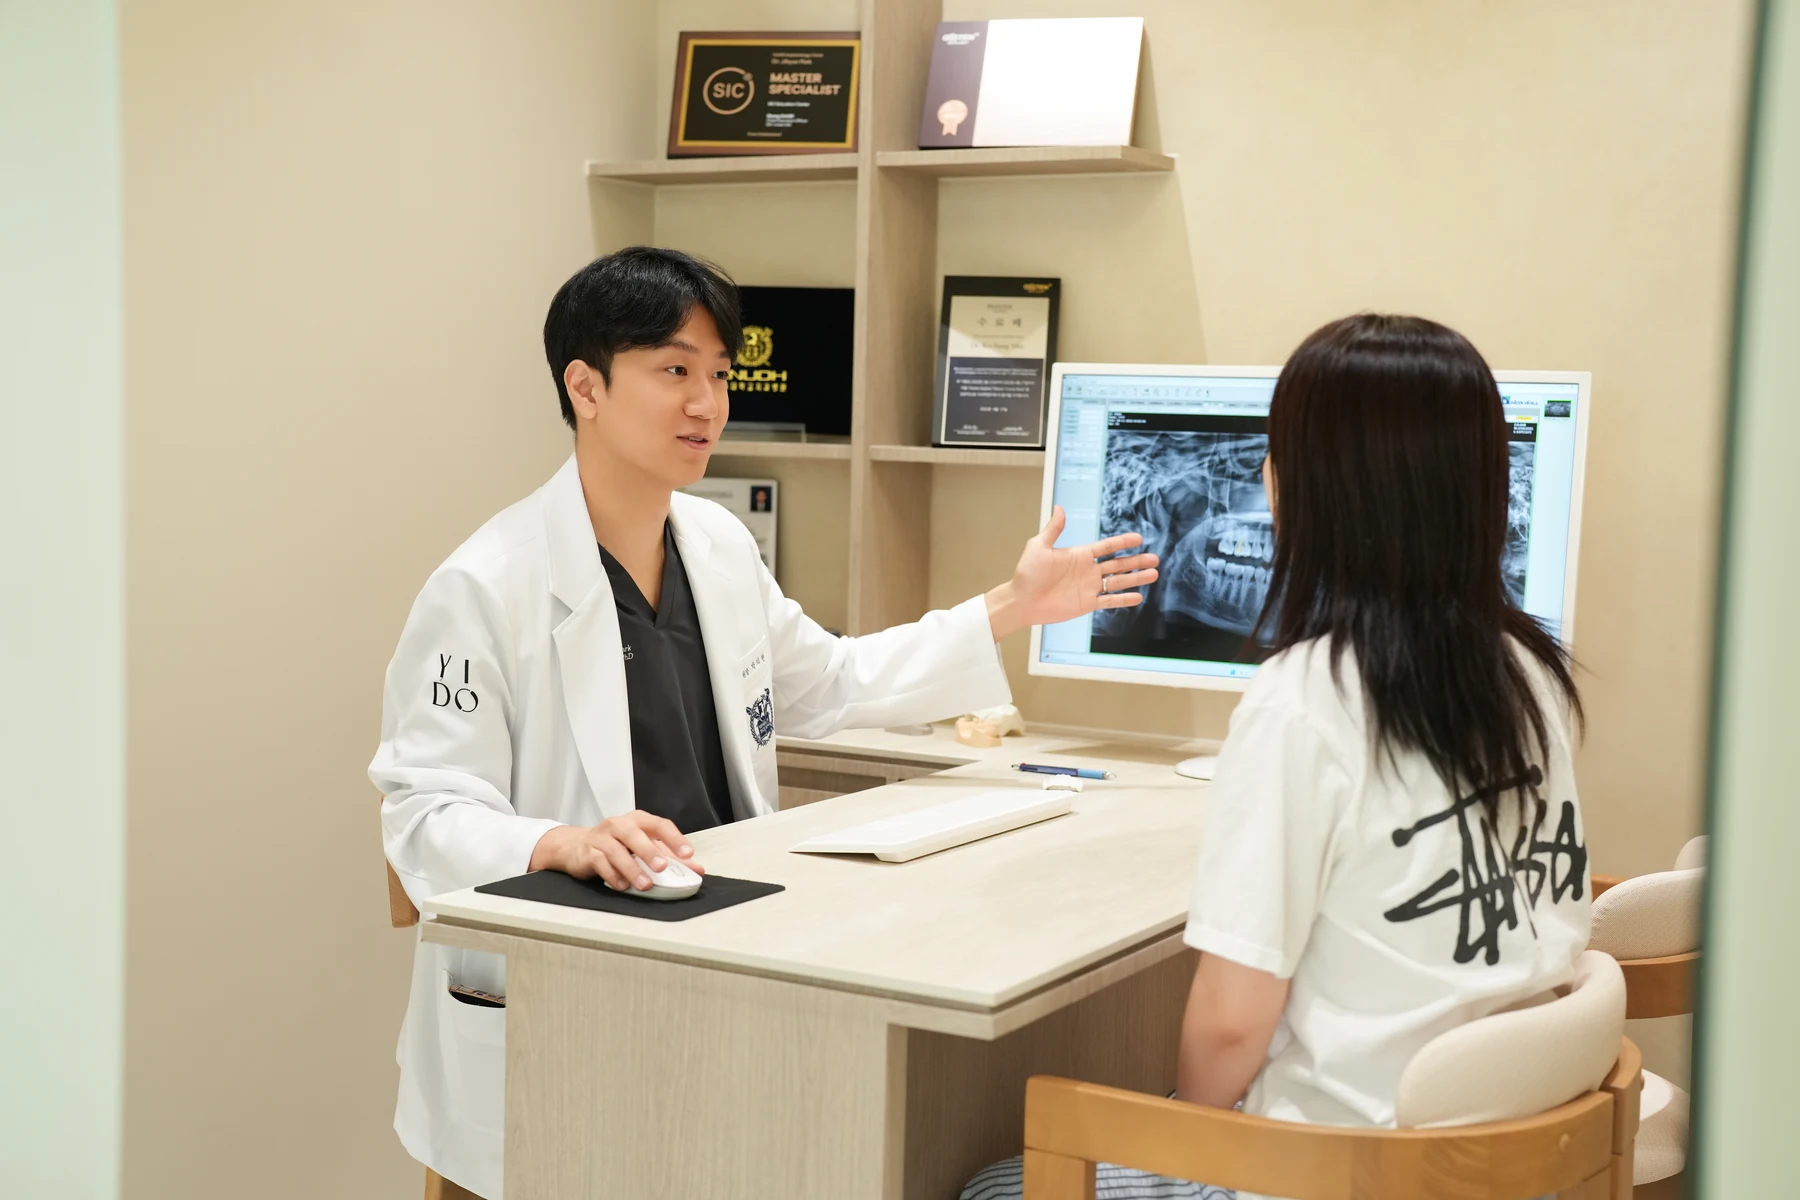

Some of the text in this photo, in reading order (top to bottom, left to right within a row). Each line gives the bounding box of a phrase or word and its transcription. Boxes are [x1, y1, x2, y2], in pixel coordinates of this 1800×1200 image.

[769, 72, 822, 83] MASTER
[712, 83, 746, 98] SIC
[768, 84, 841, 95] SPECIALIST
[728, 369, 788, 382] NUDH
[440, 653, 469, 684] YI
[432, 681, 479, 713] DO
